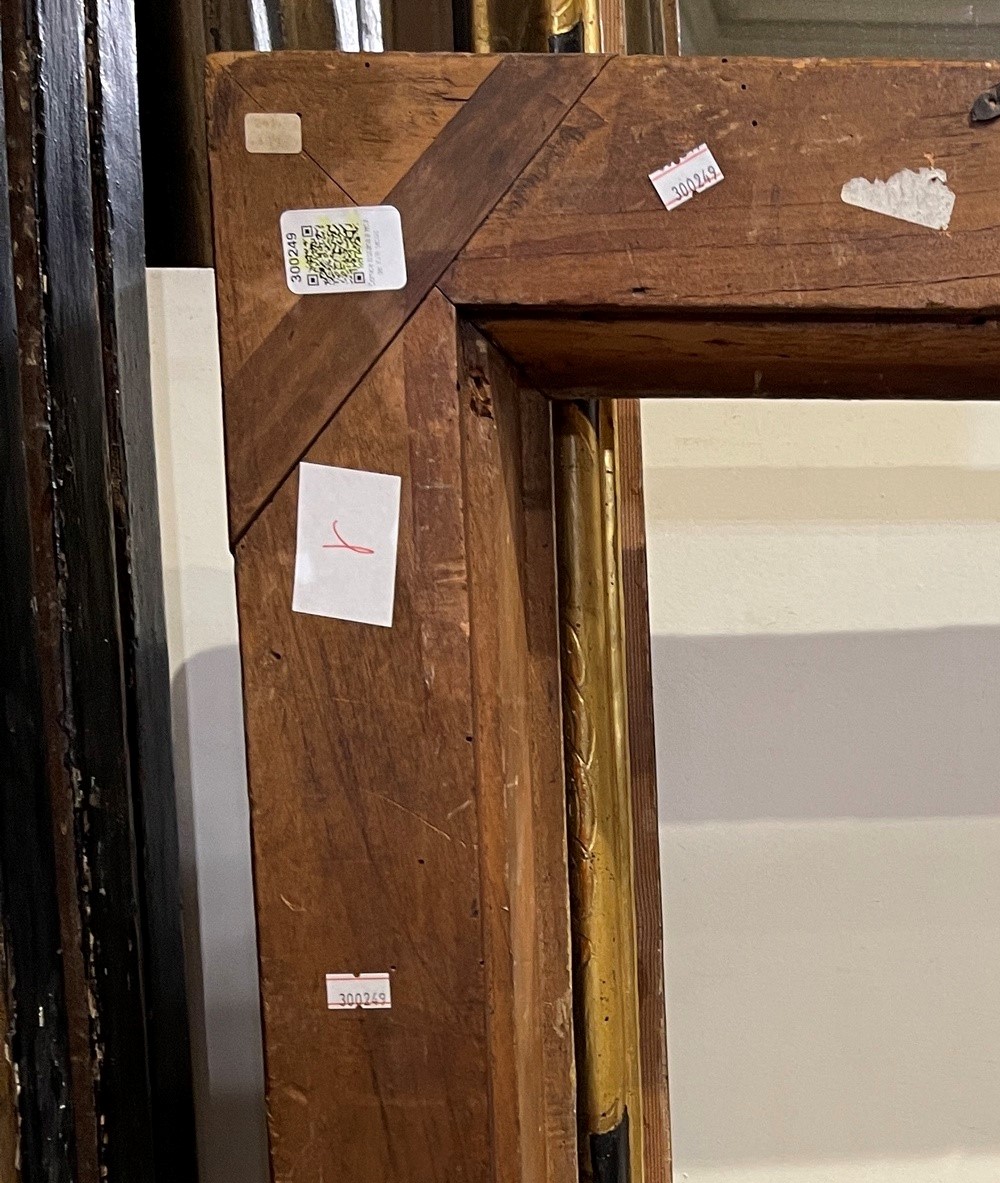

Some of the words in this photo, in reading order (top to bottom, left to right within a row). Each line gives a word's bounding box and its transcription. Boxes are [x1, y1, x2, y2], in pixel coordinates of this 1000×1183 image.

[671, 165, 717, 201] 300249
[286, 232, 302, 283] 300249
[339, 992, 386, 1007] 300249
